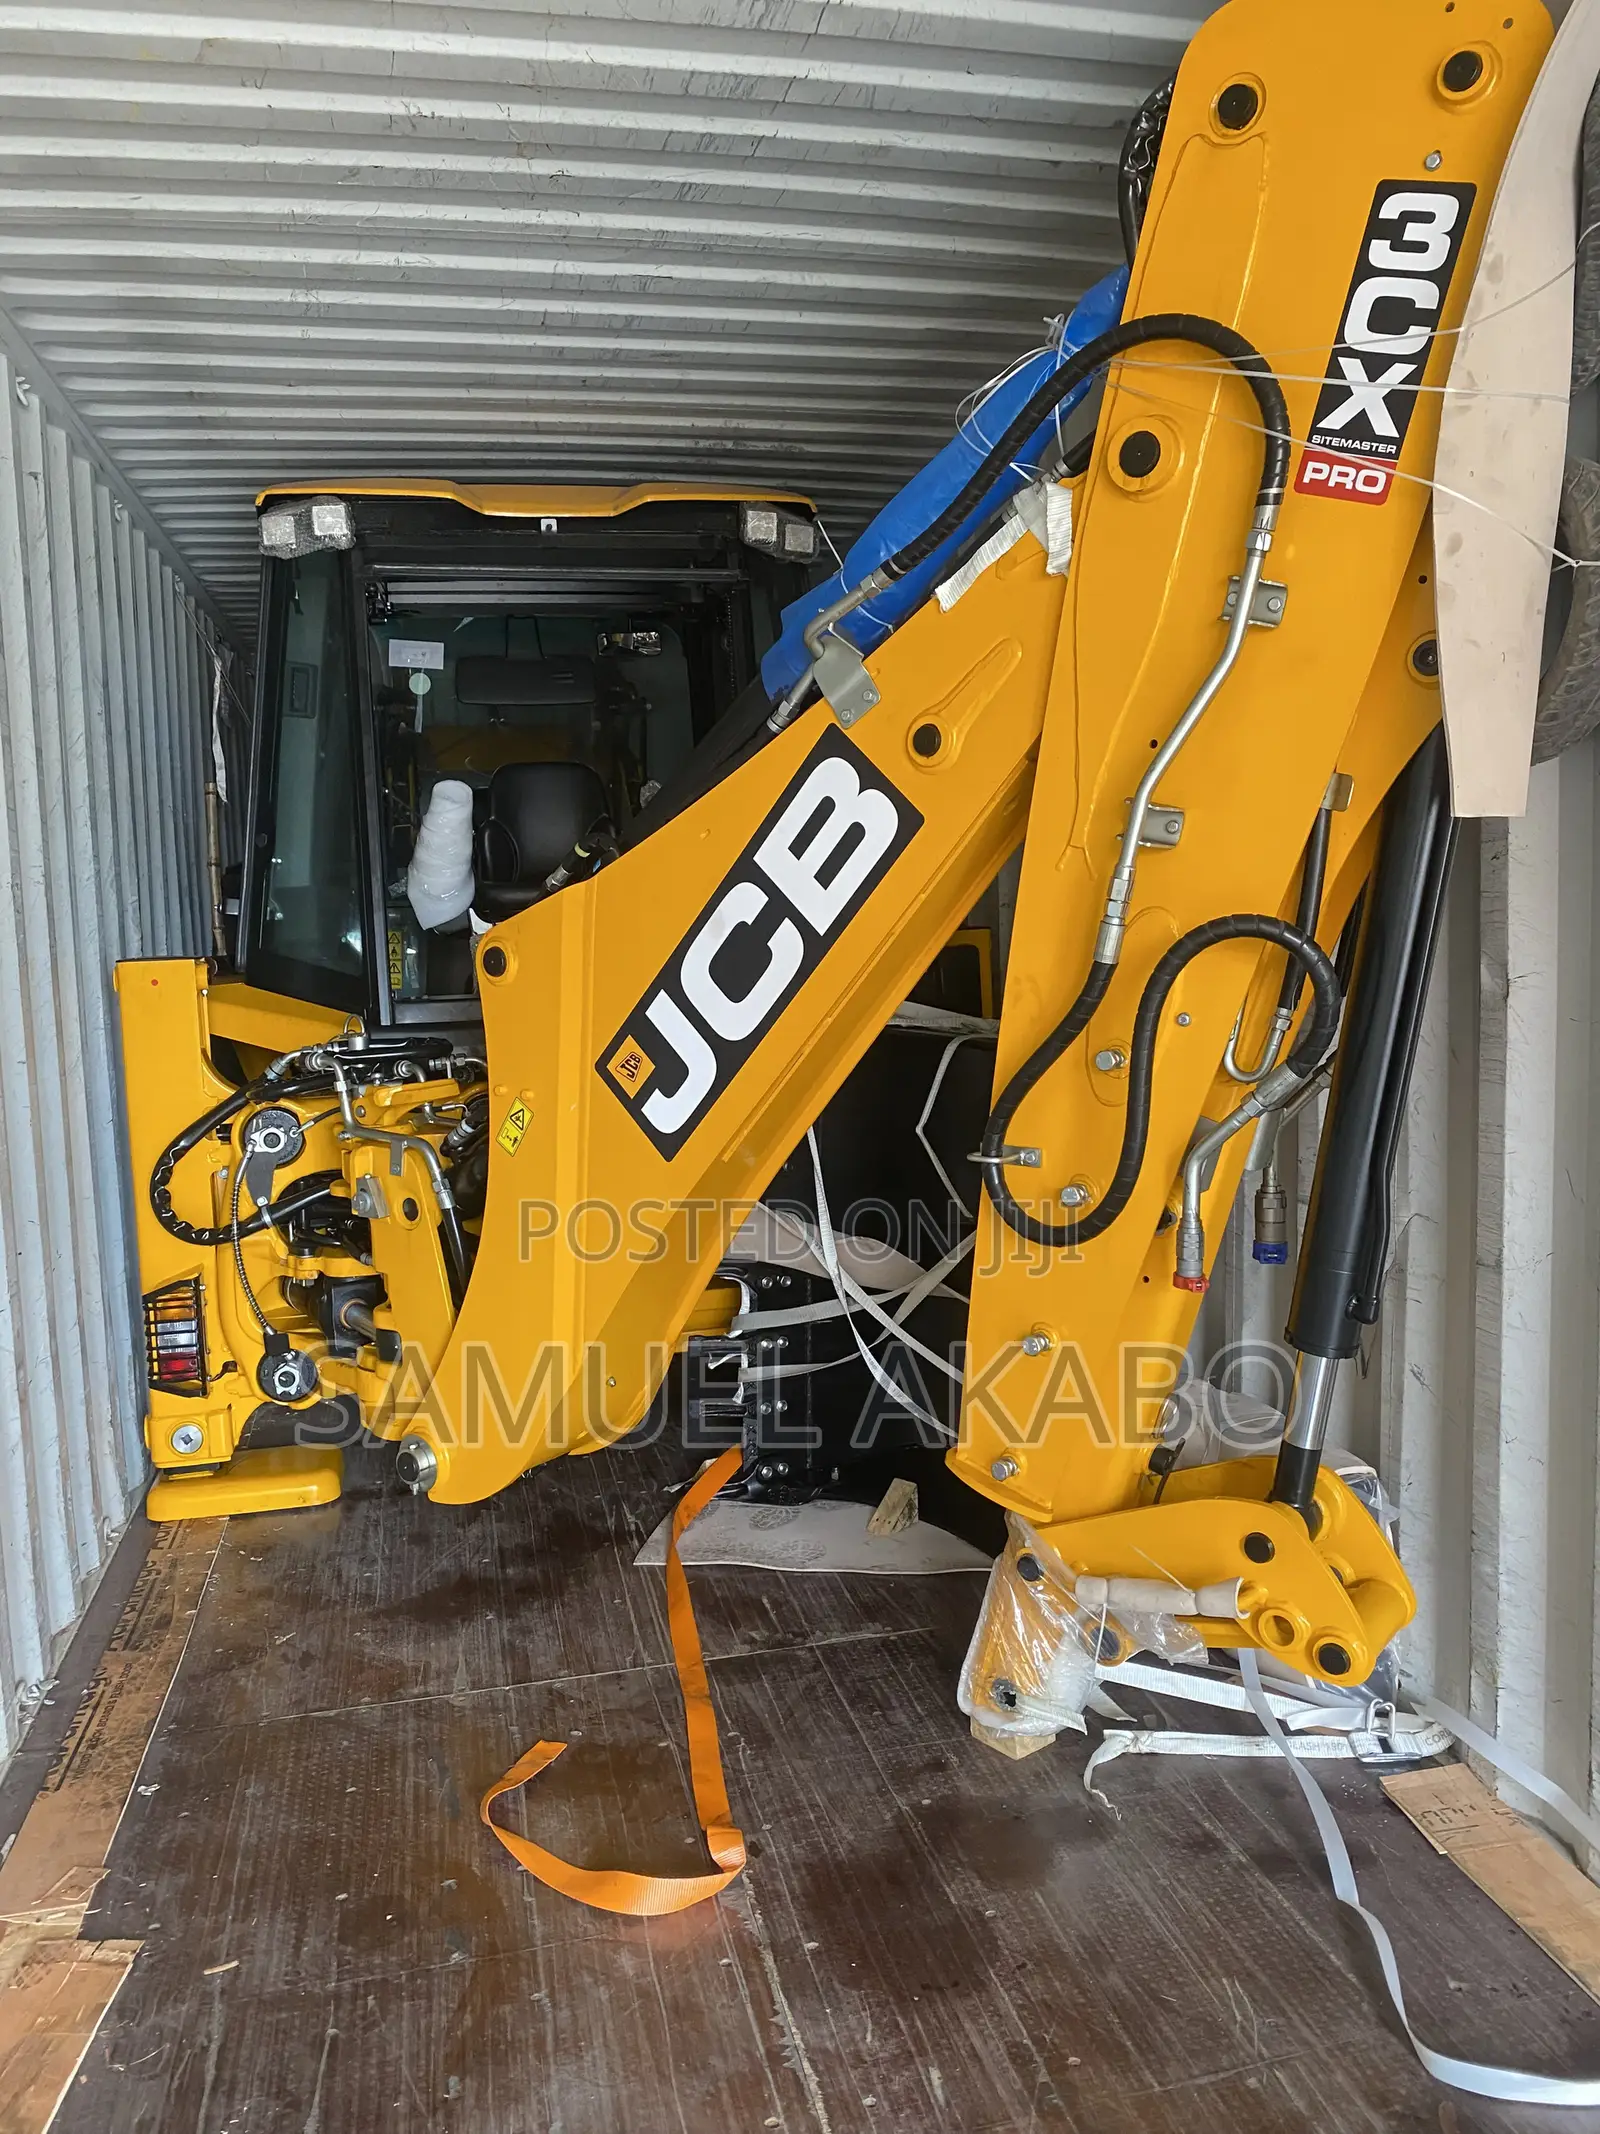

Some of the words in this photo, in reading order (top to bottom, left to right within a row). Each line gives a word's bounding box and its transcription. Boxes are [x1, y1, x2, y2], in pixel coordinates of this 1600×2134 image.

[1316, 192, 1460, 438] 3CX
[1311, 434, 1397, 455] SITEMASTER
[1302, 461, 1388, 494] PRO
[641, 756, 899, 1134] JCB
[620, 1053, 641, 1079] JCB
